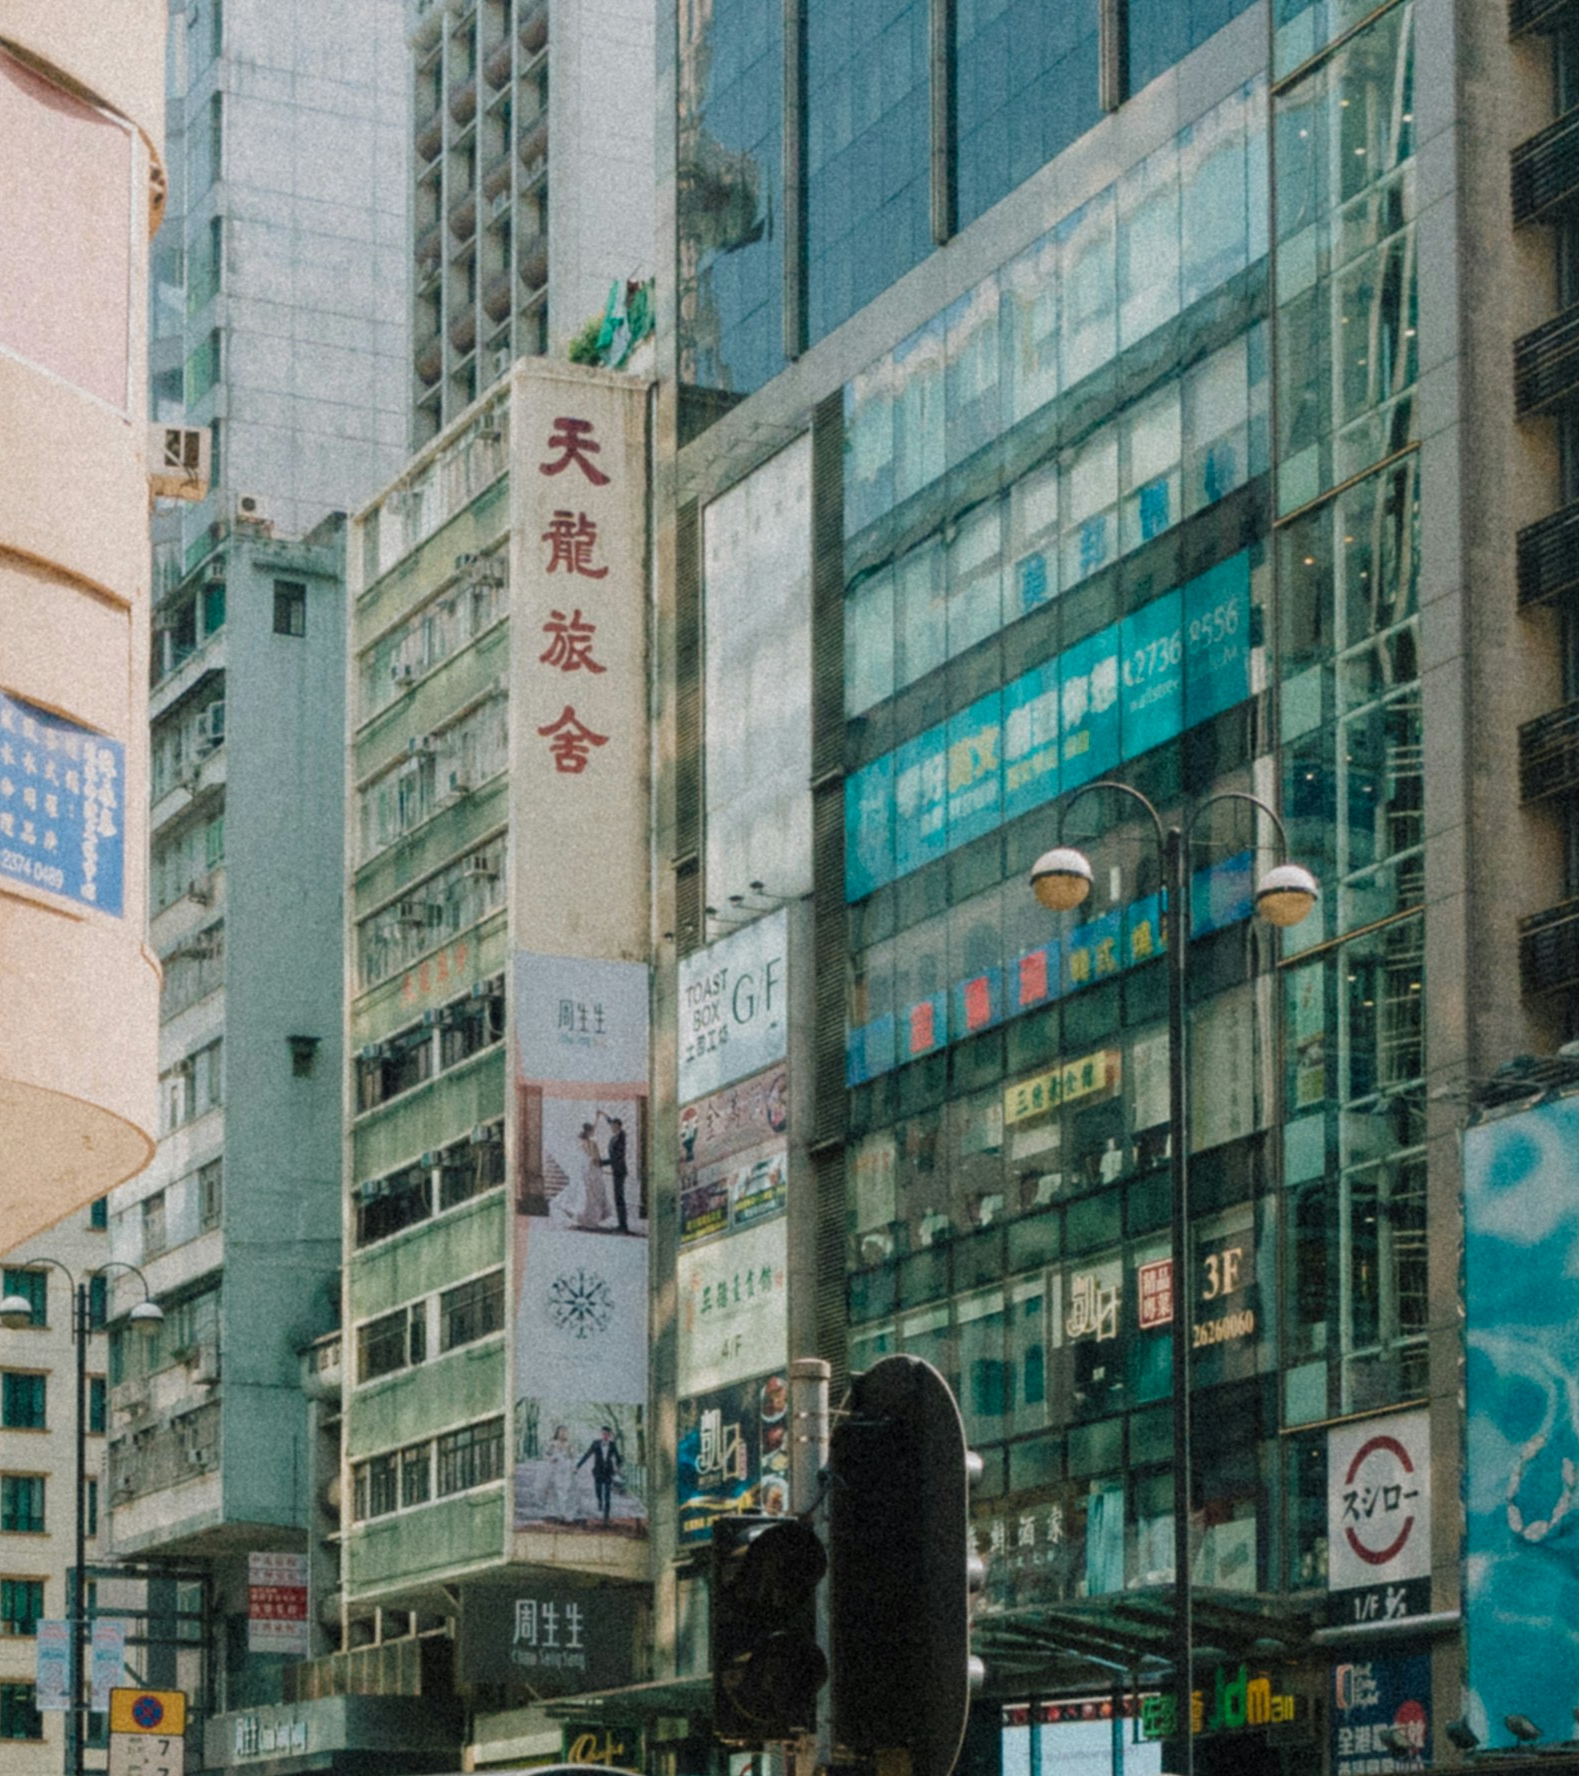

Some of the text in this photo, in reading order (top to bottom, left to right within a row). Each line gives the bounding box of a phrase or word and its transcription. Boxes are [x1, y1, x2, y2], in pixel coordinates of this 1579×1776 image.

[537, 416, 611, 774] 天龍旅舍
[685, 968, 728, 1008] TOAST
[732, 956, 782, 1025] G/F
[558, 998, 606, 1035] 周生生
[693, 1000, 720, 1032] BOX
[1203, 1248, 1242, 1299] 3F
[1342, 1483, 1419, 1521] スシロー
[512, 1599, 584, 1648] 周生生
[1354, 1594, 1380, 1621] 1/F
[158, 1740, 170, 1757] 7
